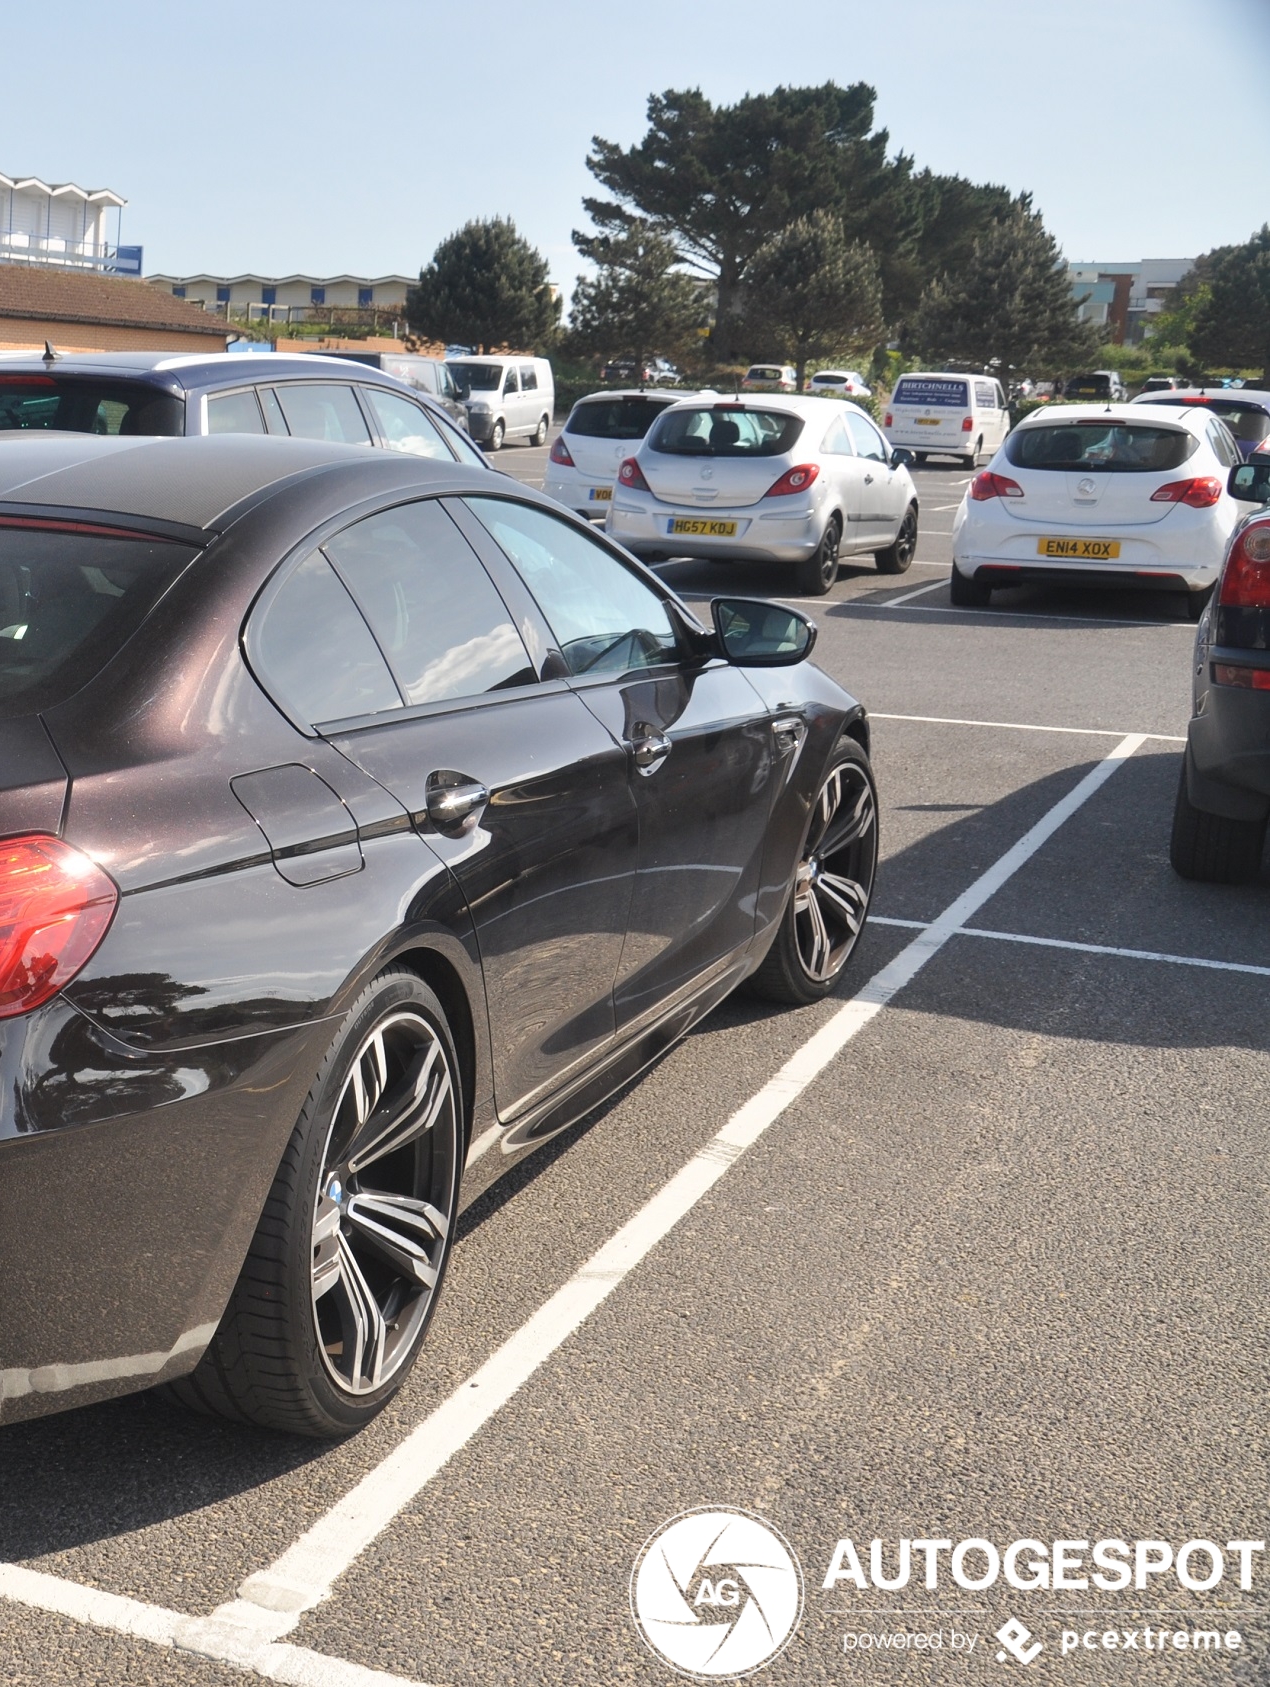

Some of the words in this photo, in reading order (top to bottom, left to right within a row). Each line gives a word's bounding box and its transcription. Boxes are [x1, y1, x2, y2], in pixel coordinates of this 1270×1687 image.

[902, 382, 964, 391] BIRTCHNELLS
[674, 520, 707, 534] HG57
[709, 521, 737, 535] KDJ
[1046, 540, 1079, 555] EN14
[1082, 542, 1112, 556] XOX
